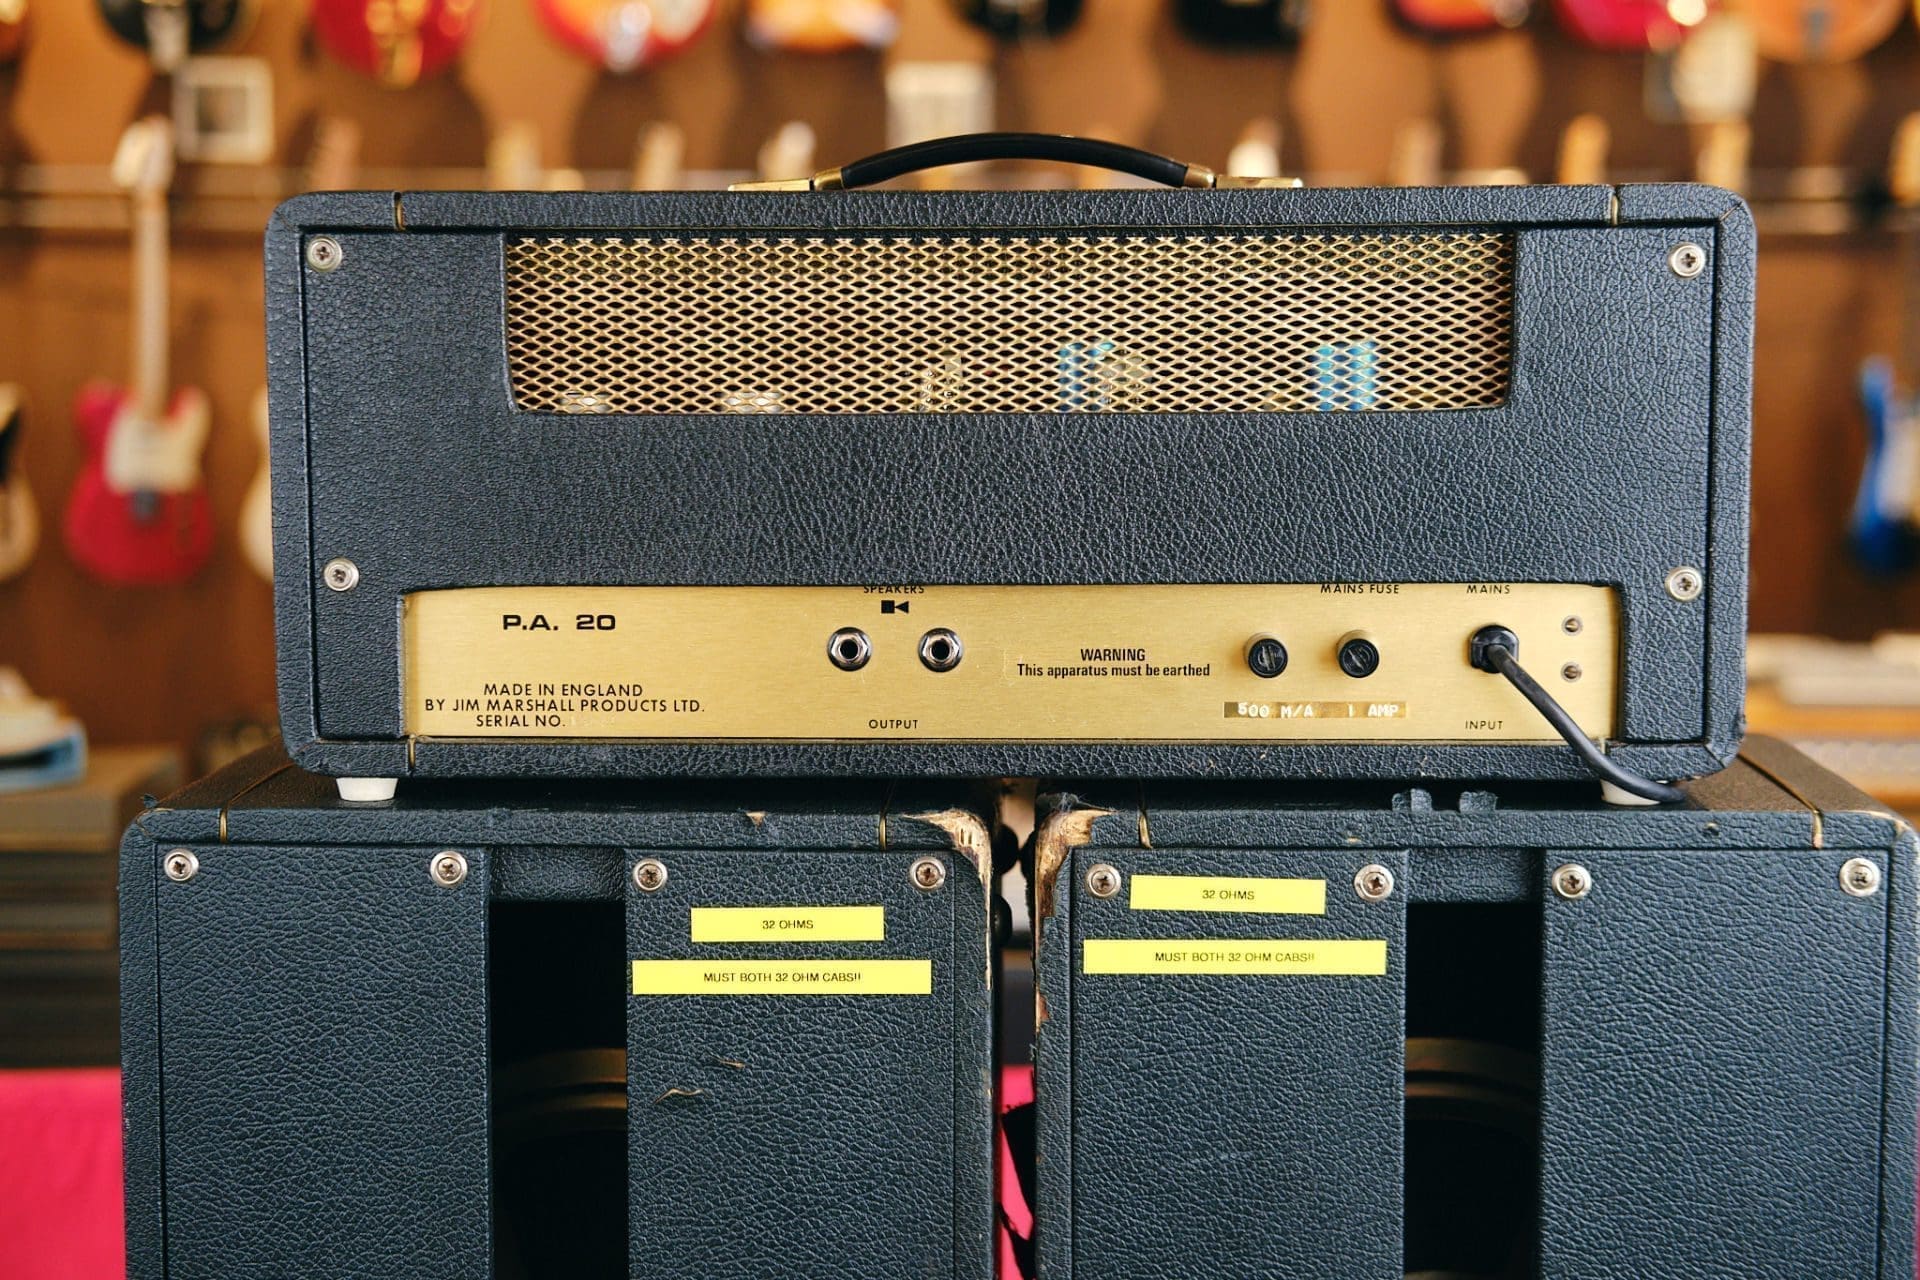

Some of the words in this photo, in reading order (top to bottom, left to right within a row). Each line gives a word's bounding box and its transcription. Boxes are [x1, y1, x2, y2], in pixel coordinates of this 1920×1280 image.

[863, 584, 925, 594] SPEAKERS
[1320, 584, 1364, 594] MAINS
[1369, 584, 1400, 594] FUSE
[1466, 584, 1510, 594] MAINS
[502, 614, 559, 631] P.A.
[575, 614, 616, 631] 20
[1080, 648, 1146, 662] WARNING
[1016, 664, 1044, 677] This
[1047, 665, 1108, 679] apparatus
[1111, 665, 1143, 677] must
[1146, 664, 1161, 677] be
[1163, 664, 1211, 677] earthed
[484, 683, 533, 697] MADE
[538, 683, 555, 697] IN
[561, 683, 643, 697] ENGLAND
[425, 699, 446, 712] BY
[452, 699, 480, 712] JIM
[486, 699, 575, 713] MARSHALL
[580, 699, 668, 713] PRODUCTS
[673, 699, 705, 713] LTD.
[1237, 701, 1270, 718] 500
[1280, 703, 1314, 718] M/A
[1367, 703, 1400, 718] AMP
[476, 714, 530, 728] SERIAL
[535, 714, 566, 728] NO.
[868, 719, 919, 730] OUTPUT
[1465, 720, 1504, 731] INPUT
[1202, 889, 1216, 900] 32
[1219, 890, 1255, 901] OHMS
[762, 919, 776, 930] 32
[779, 919, 814, 930] OHMS
[1154, 951, 1188, 962] MUST
[1191, 952, 1225, 962] BOTH
[1228, 952, 1241, 962] 32
[1244, 952, 1272, 962] OHM
[703, 972, 736, 983] MUST
[740, 972, 772, 983] BOTH
[775, 972, 789, 983] 32
[792, 972, 820, 983] OHM
[822, 972, 861, 983] CABS!!
